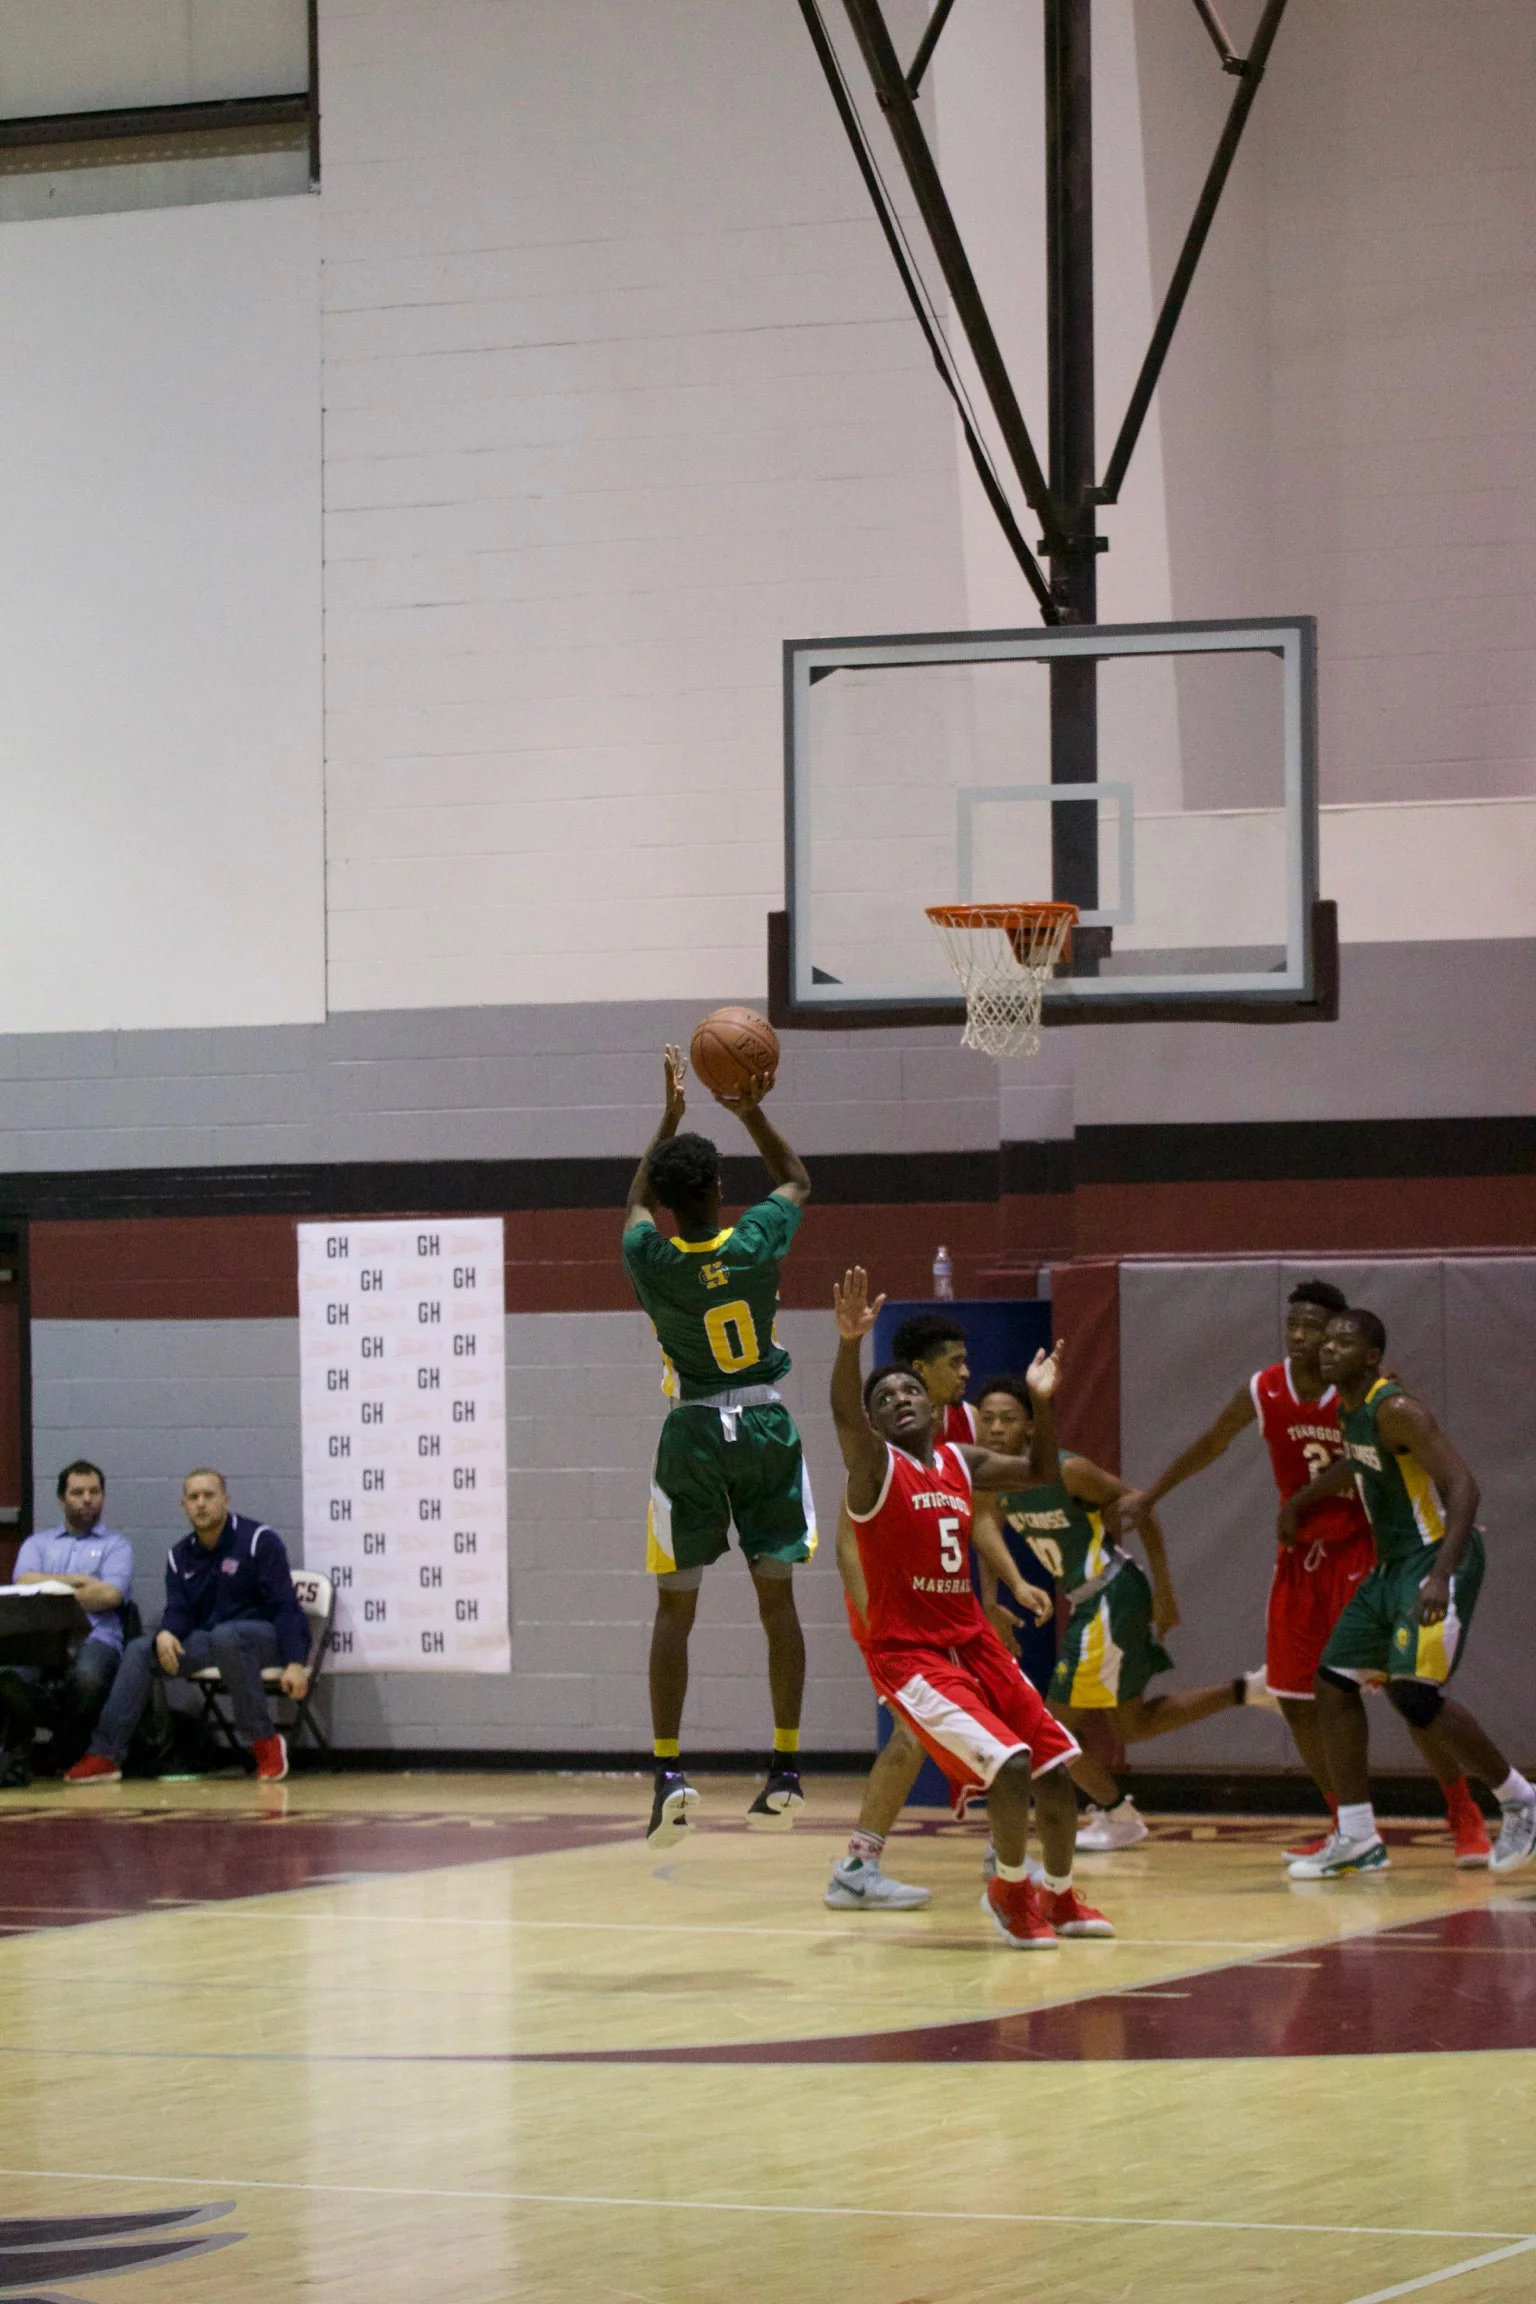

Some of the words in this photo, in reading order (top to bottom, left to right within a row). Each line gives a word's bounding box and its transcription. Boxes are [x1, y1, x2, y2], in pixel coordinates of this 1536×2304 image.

[327, 1237, 349, 1258] GH
[417, 1235, 440, 1256] GH
[361, 1270, 383, 1291] GH
[453, 1267, 476, 1289] GH
[327, 1304, 349, 1325] GH
[418, 1302, 441, 1324] GH
[361, 1337, 384, 1358] GH
[453, 1334, 476, 1356] GH
[704, 1300, 760, 1373] 0
[327, 1369, 349, 1391] GH
[418, 1368, 440, 1389] GH
[361, 1402, 383, 1424] GH
[452, 1401, 475, 1422] GH
[328, 1435, 350, 1457] GH
[418, 1435, 440, 1456] GH
[362, 1469, 384, 1491] GH
[453, 1467, 476, 1489] GH
[330, 1499, 352, 1521] GH
[419, 1499, 441, 1521] GH
[363, 1533, 386, 1555] GH
[454, 1532, 476, 1554] GH
[938, 1517, 963, 1573] 5
[331, 1565, 353, 1588] GH
[419, 1566, 442, 1588] GH
[364, 1599, 386, 1622] GH
[455, 1599, 478, 1621] GH
[331, 1630, 353, 1653] GH
[421, 1631, 444, 1653] GH
